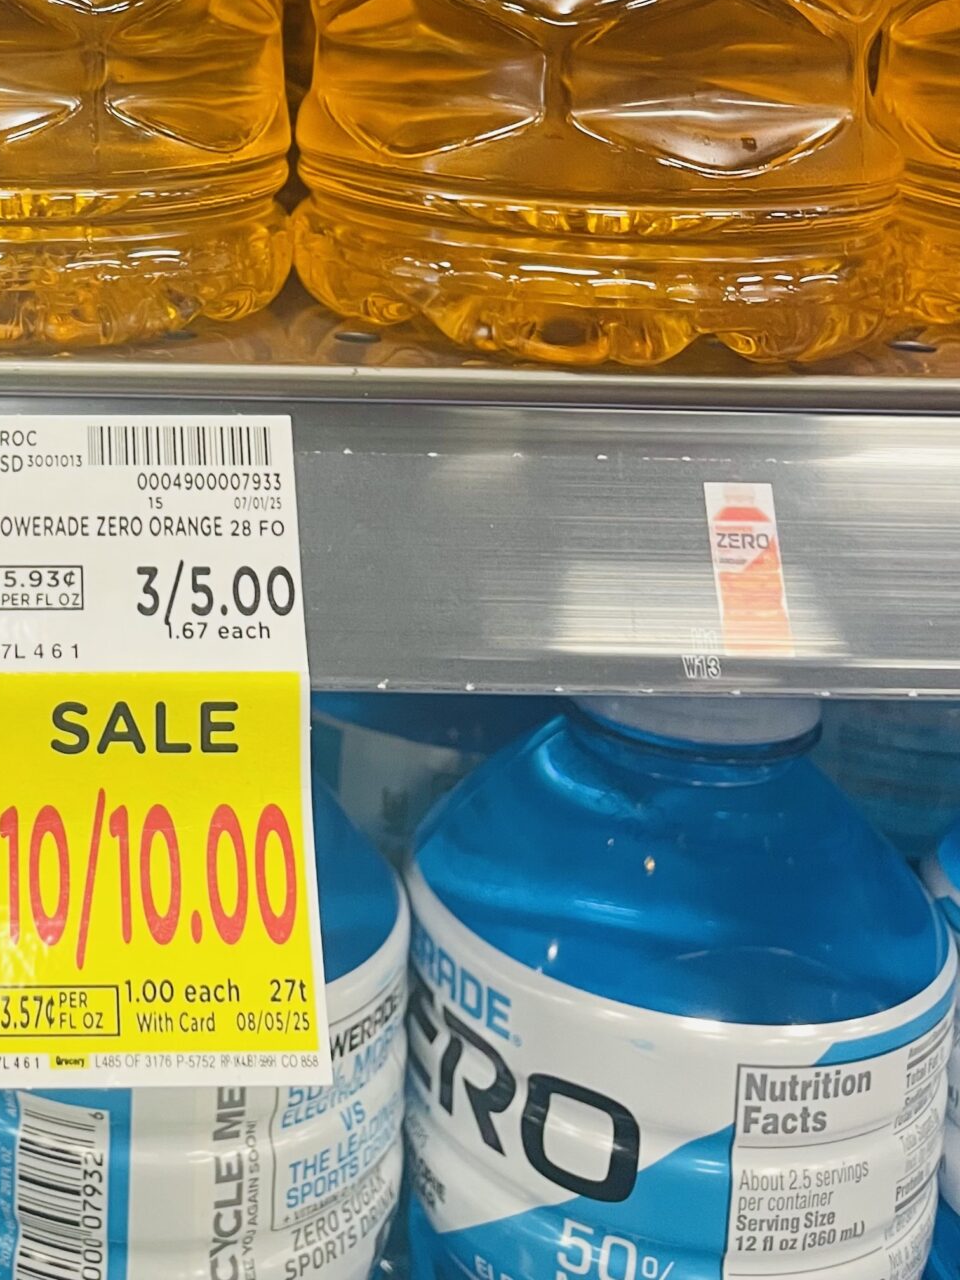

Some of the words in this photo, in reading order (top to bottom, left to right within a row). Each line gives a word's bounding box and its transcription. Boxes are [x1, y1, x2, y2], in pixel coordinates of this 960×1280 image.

[26, 454, 83, 468] 3001013
[136, 472, 283, 491] 0004900007933
[147, 496, 164, 510] 15
[233, 496, 283, 511] 07/01/25
[96, 515, 144, 537] ZERO
[148, 515, 223, 537] ORANGE
[229, 519, 252, 537] 28
[258, 519, 286, 537] FO
[715, 532, 770, 550] ZERO
[3, 570, 76, 588] 5.93¢
[1, 593, 30, 606] PER
[35, 593, 53, 606] FL
[58, 592, 81, 606] OZ
[135, 559, 296, 626] 3/5.00
[166, 621, 209, 640] 1.67
[217, 621, 271, 640] each
[33, 643, 45, 659] 4
[51, 643, 63, 659] 6
[48, 700, 241, 755] SALE
[58, 991, 89, 1008] PER
[124, 978, 175, 1004] 1.00
[183, 978, 241, 1004] each
[269, 978, 309, 1003] 27t
[0, 994, 55, 1031] 3.57¢
[58, 1013, 78, 1030] FL
[82, 1012, 105, 1030] OZ
[135, 1011, 174, 1033] With
[178, 1011, 217, 1033] Card
[235, 1009, 311, 1033] 08/05/25
[55, 1055, 86, 1068] Grocery
[94, 1054, 122, 1069] L485
[124, 1054, 141, 1069] OF
[144, 1054, 173, 1069] 3176
[175, 1054, 216, 1070] P-5752
[281, 1054, 299, 1069] CO
[744, 1069, 873, 1104] Nutrition
[212, 1086, 249, 1143] ME
[339, 1100, 367, 1132] VS
[742, 1105, 828, 1136] Facts
[288, 1146, 331, 1185] THE
[739, 1169, 785, 1192] About
[789, 1168, 812, 1191] 2.5
[815, 1159, 870, 1186] servings
[286, 1154, 361, 1210] SPORTS
[243, 1176, 260, 1227] AGAIN
[738, 1195, 765, 1215] per
[767, 1189, 835, 1212] container
[291, 1208, 340, 1253] ZERO
[735, 1214, 801, 1235] Serving
[803, 1210, 837, 1231] Size
[735, 1235, 758, 1253] 12
[762, 1234, 774, 1252] fl
[778, 1238, 799, 1253] oz
[801, 1228, 837, 1253] (360
[839, 1220, 866, 1242] mL)
[284, 1225, 358, 1280] SPORTS
